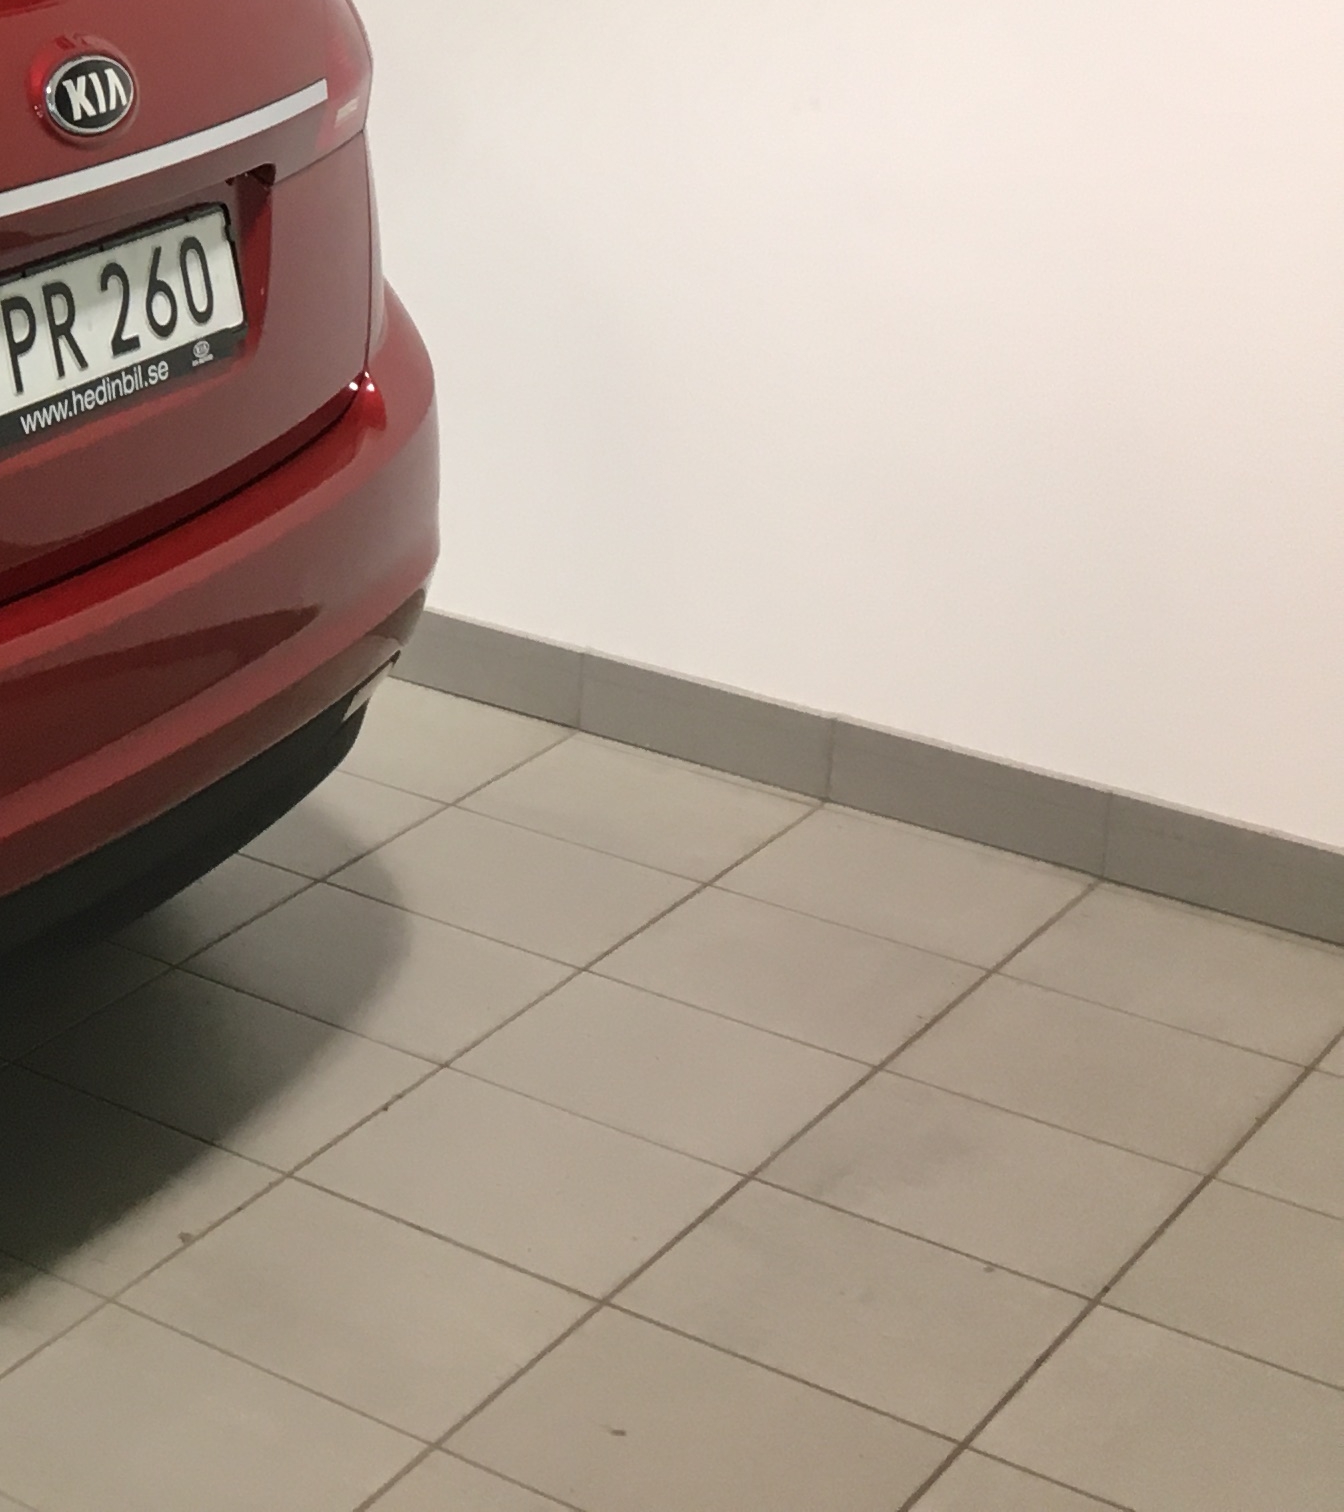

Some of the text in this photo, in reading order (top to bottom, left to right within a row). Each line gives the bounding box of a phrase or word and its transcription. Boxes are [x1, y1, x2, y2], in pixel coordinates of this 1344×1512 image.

[62, 68, 128, 122] KIA
[100, 236, 214, 358] 260
[20, 360, 170, 435] www.hedinbil.se
